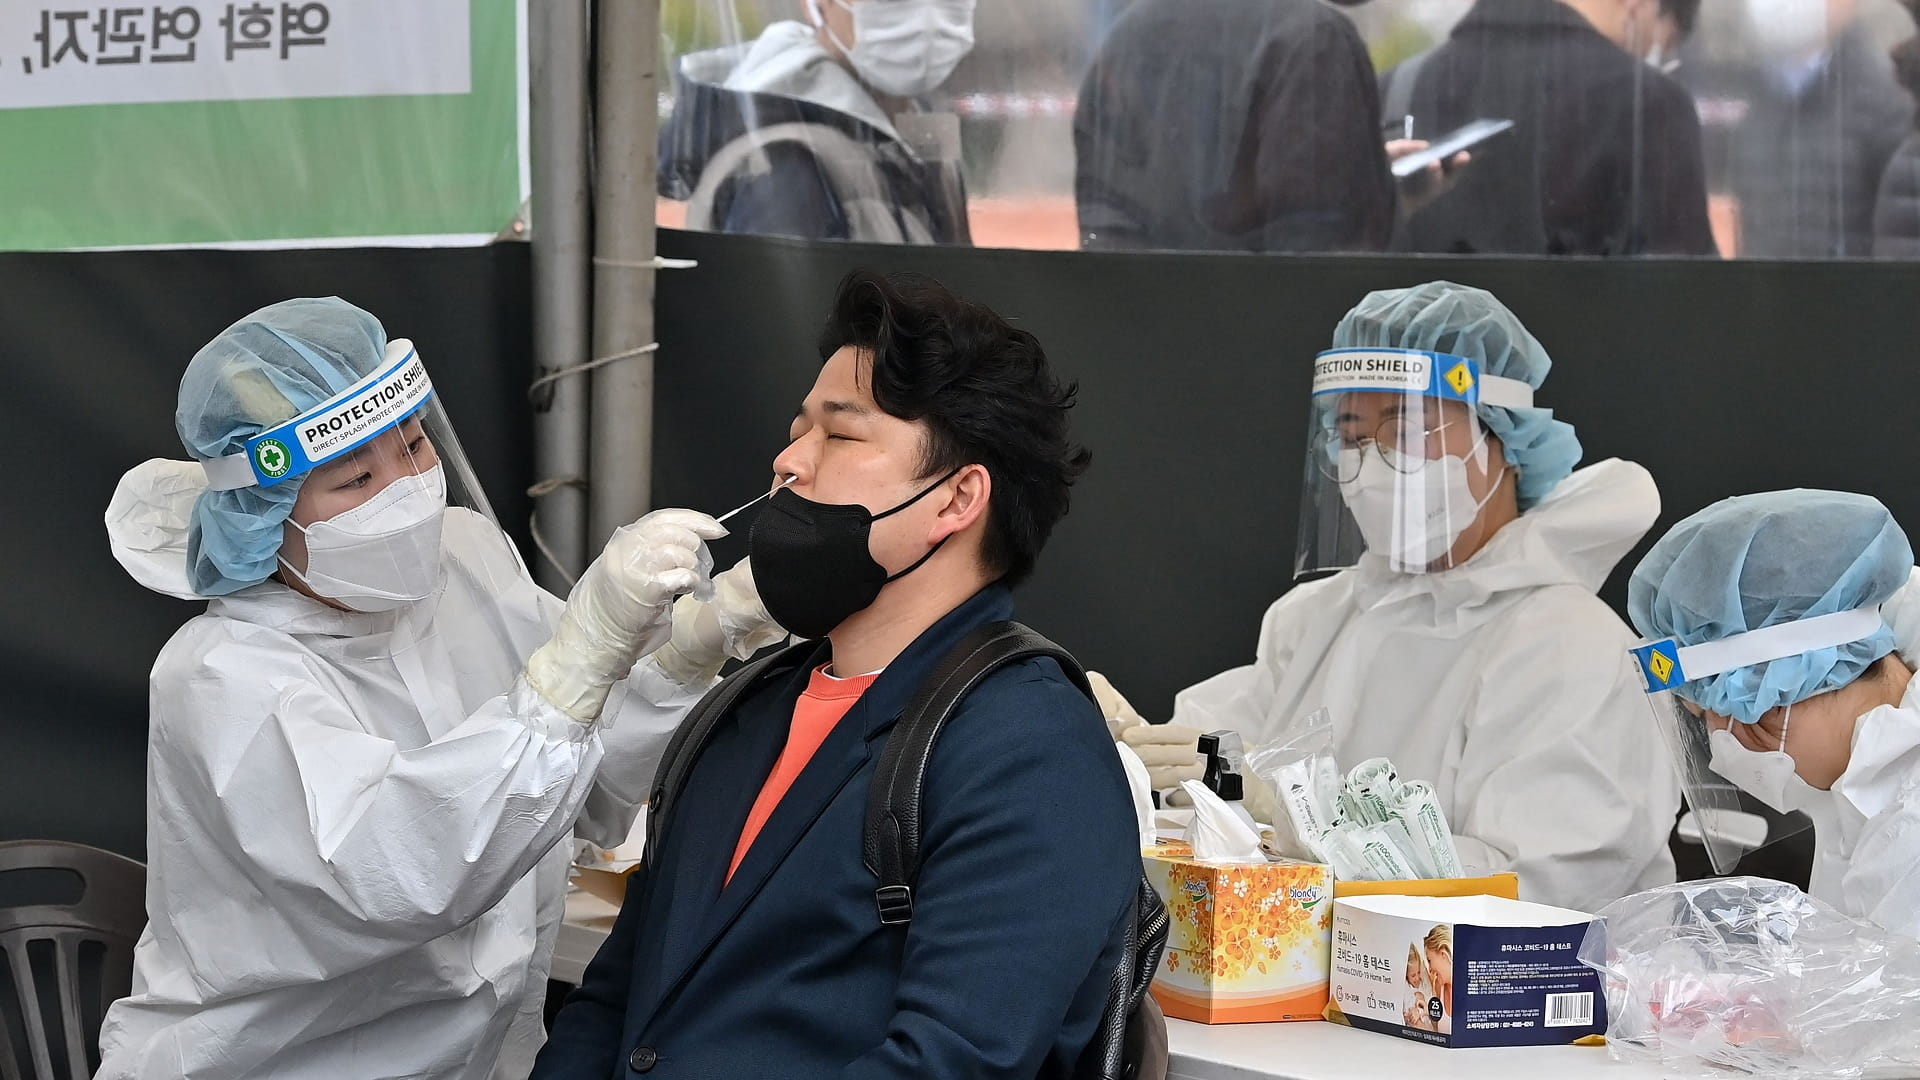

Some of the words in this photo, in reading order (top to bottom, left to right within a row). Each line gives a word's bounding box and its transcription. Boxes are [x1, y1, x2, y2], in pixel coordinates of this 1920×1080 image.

[1366, 359, 1423, 373] SHIELD
[304, 379, 404, 443] PROTECTION
[403, 360, 424, 387] SHIEL
[312, 438, 339, 454] DIRECT
[340, 421, 368, 442] SPLASH
[368, 399, 405, 426] PROTECTION
[1337, 947, 1361, 965] 코비드-19
[1362, 954, 1369, 968] 홈
[1371, 956, 1391, 971] 테스트
[1350, 967, 1369, 981] COVID-19
[1370, 973, 1382, 983] Home
[1431, 1000, 1439, 1009] 25
